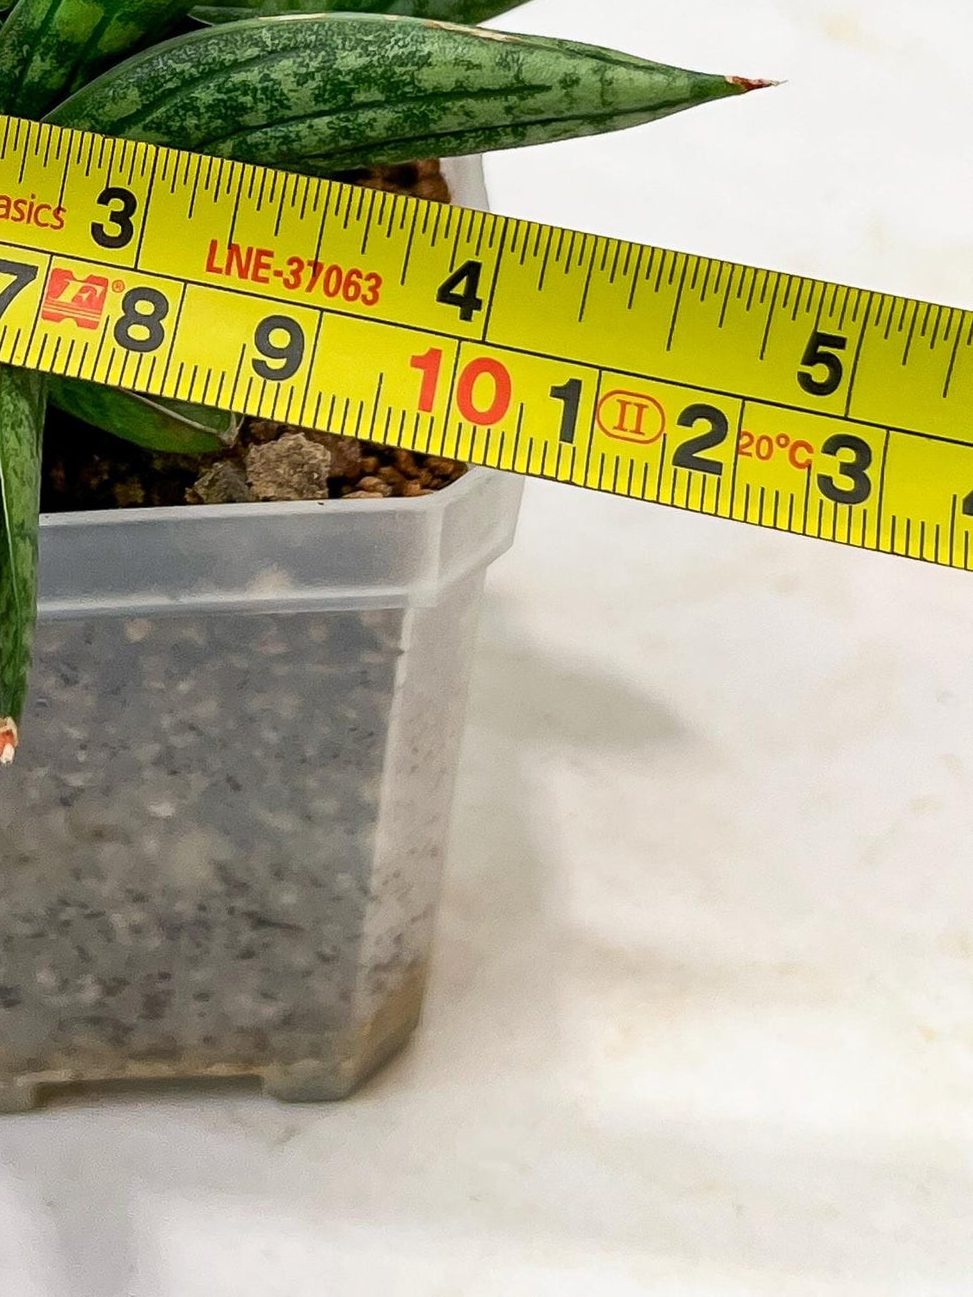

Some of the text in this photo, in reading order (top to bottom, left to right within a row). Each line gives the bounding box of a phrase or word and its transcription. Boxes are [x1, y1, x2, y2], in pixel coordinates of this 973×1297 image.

[91, 187, 138, 249] 3
[206, 239, 383, 306] LNE-37063
[436, 260, 482, 322] 4
[113, 286, 170, 353] 8
[251, 314, 305, 381] 9
[410, 348, 512, 426] 10
[797, 331, 847, 396] 5
[550, 378, 582, 445] 1
[672, 403, 728, 476] 2
[816, 433, 872, 505] 3
